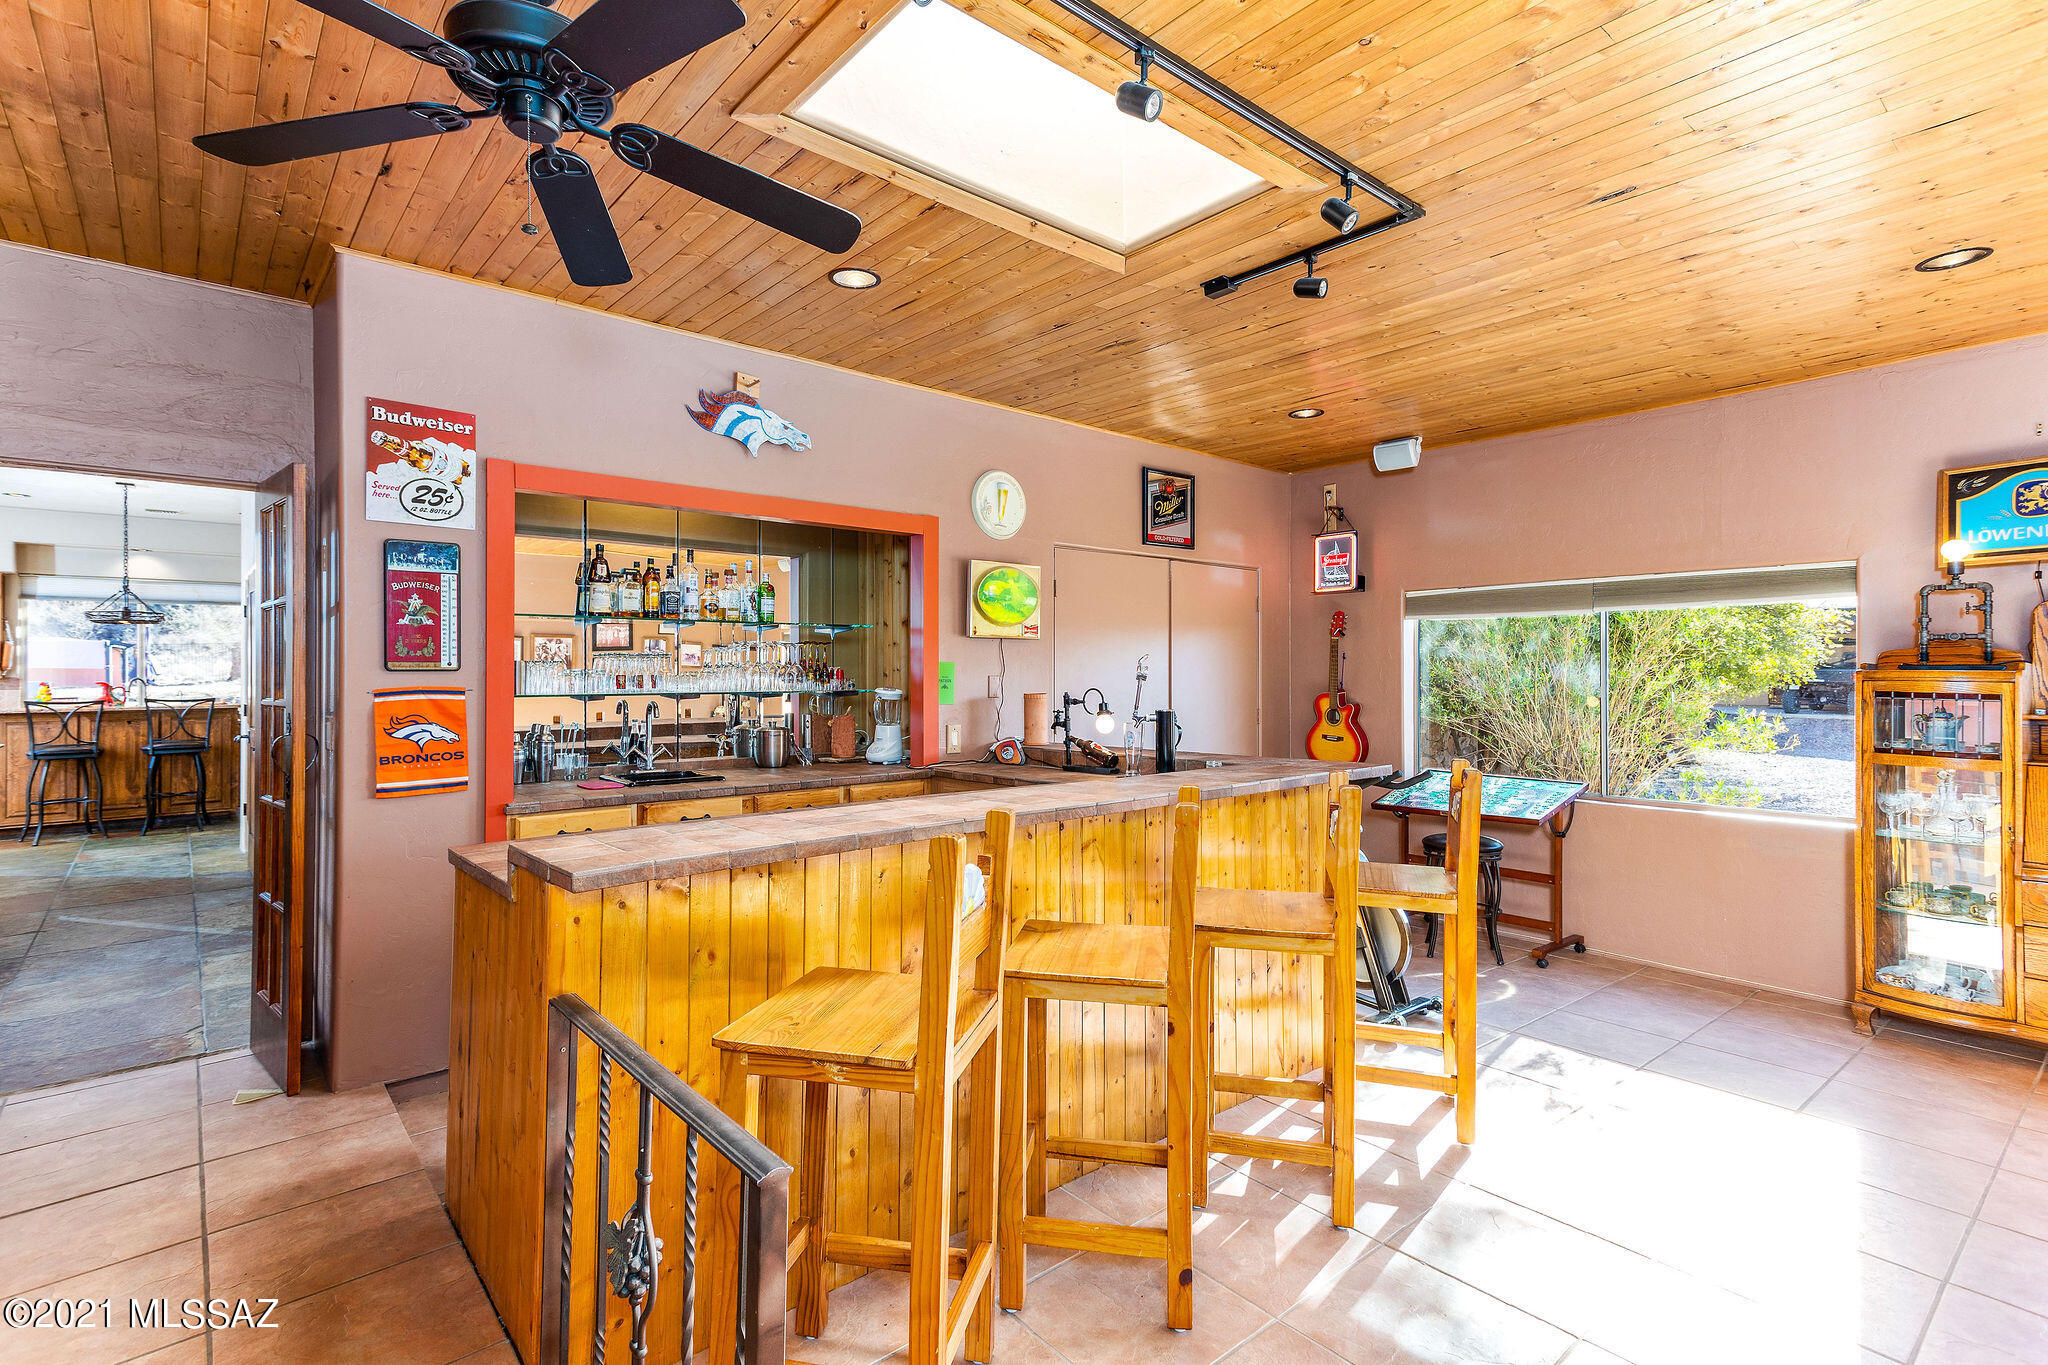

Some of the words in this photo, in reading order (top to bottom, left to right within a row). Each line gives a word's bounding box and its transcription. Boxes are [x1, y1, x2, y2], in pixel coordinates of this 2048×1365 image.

[371, 406, 473, 435] Budweiser
[372, 480, 401, 491] Served
[429, 508, 453, 516] BOTTLE
[1154, 496, 1184, 515] Miller
[1967, 525, 2048, 544] LÖWEN
[391, 582, 440, 593] BUDWEISER
[379, 751, 465, 766] BRONCOS
